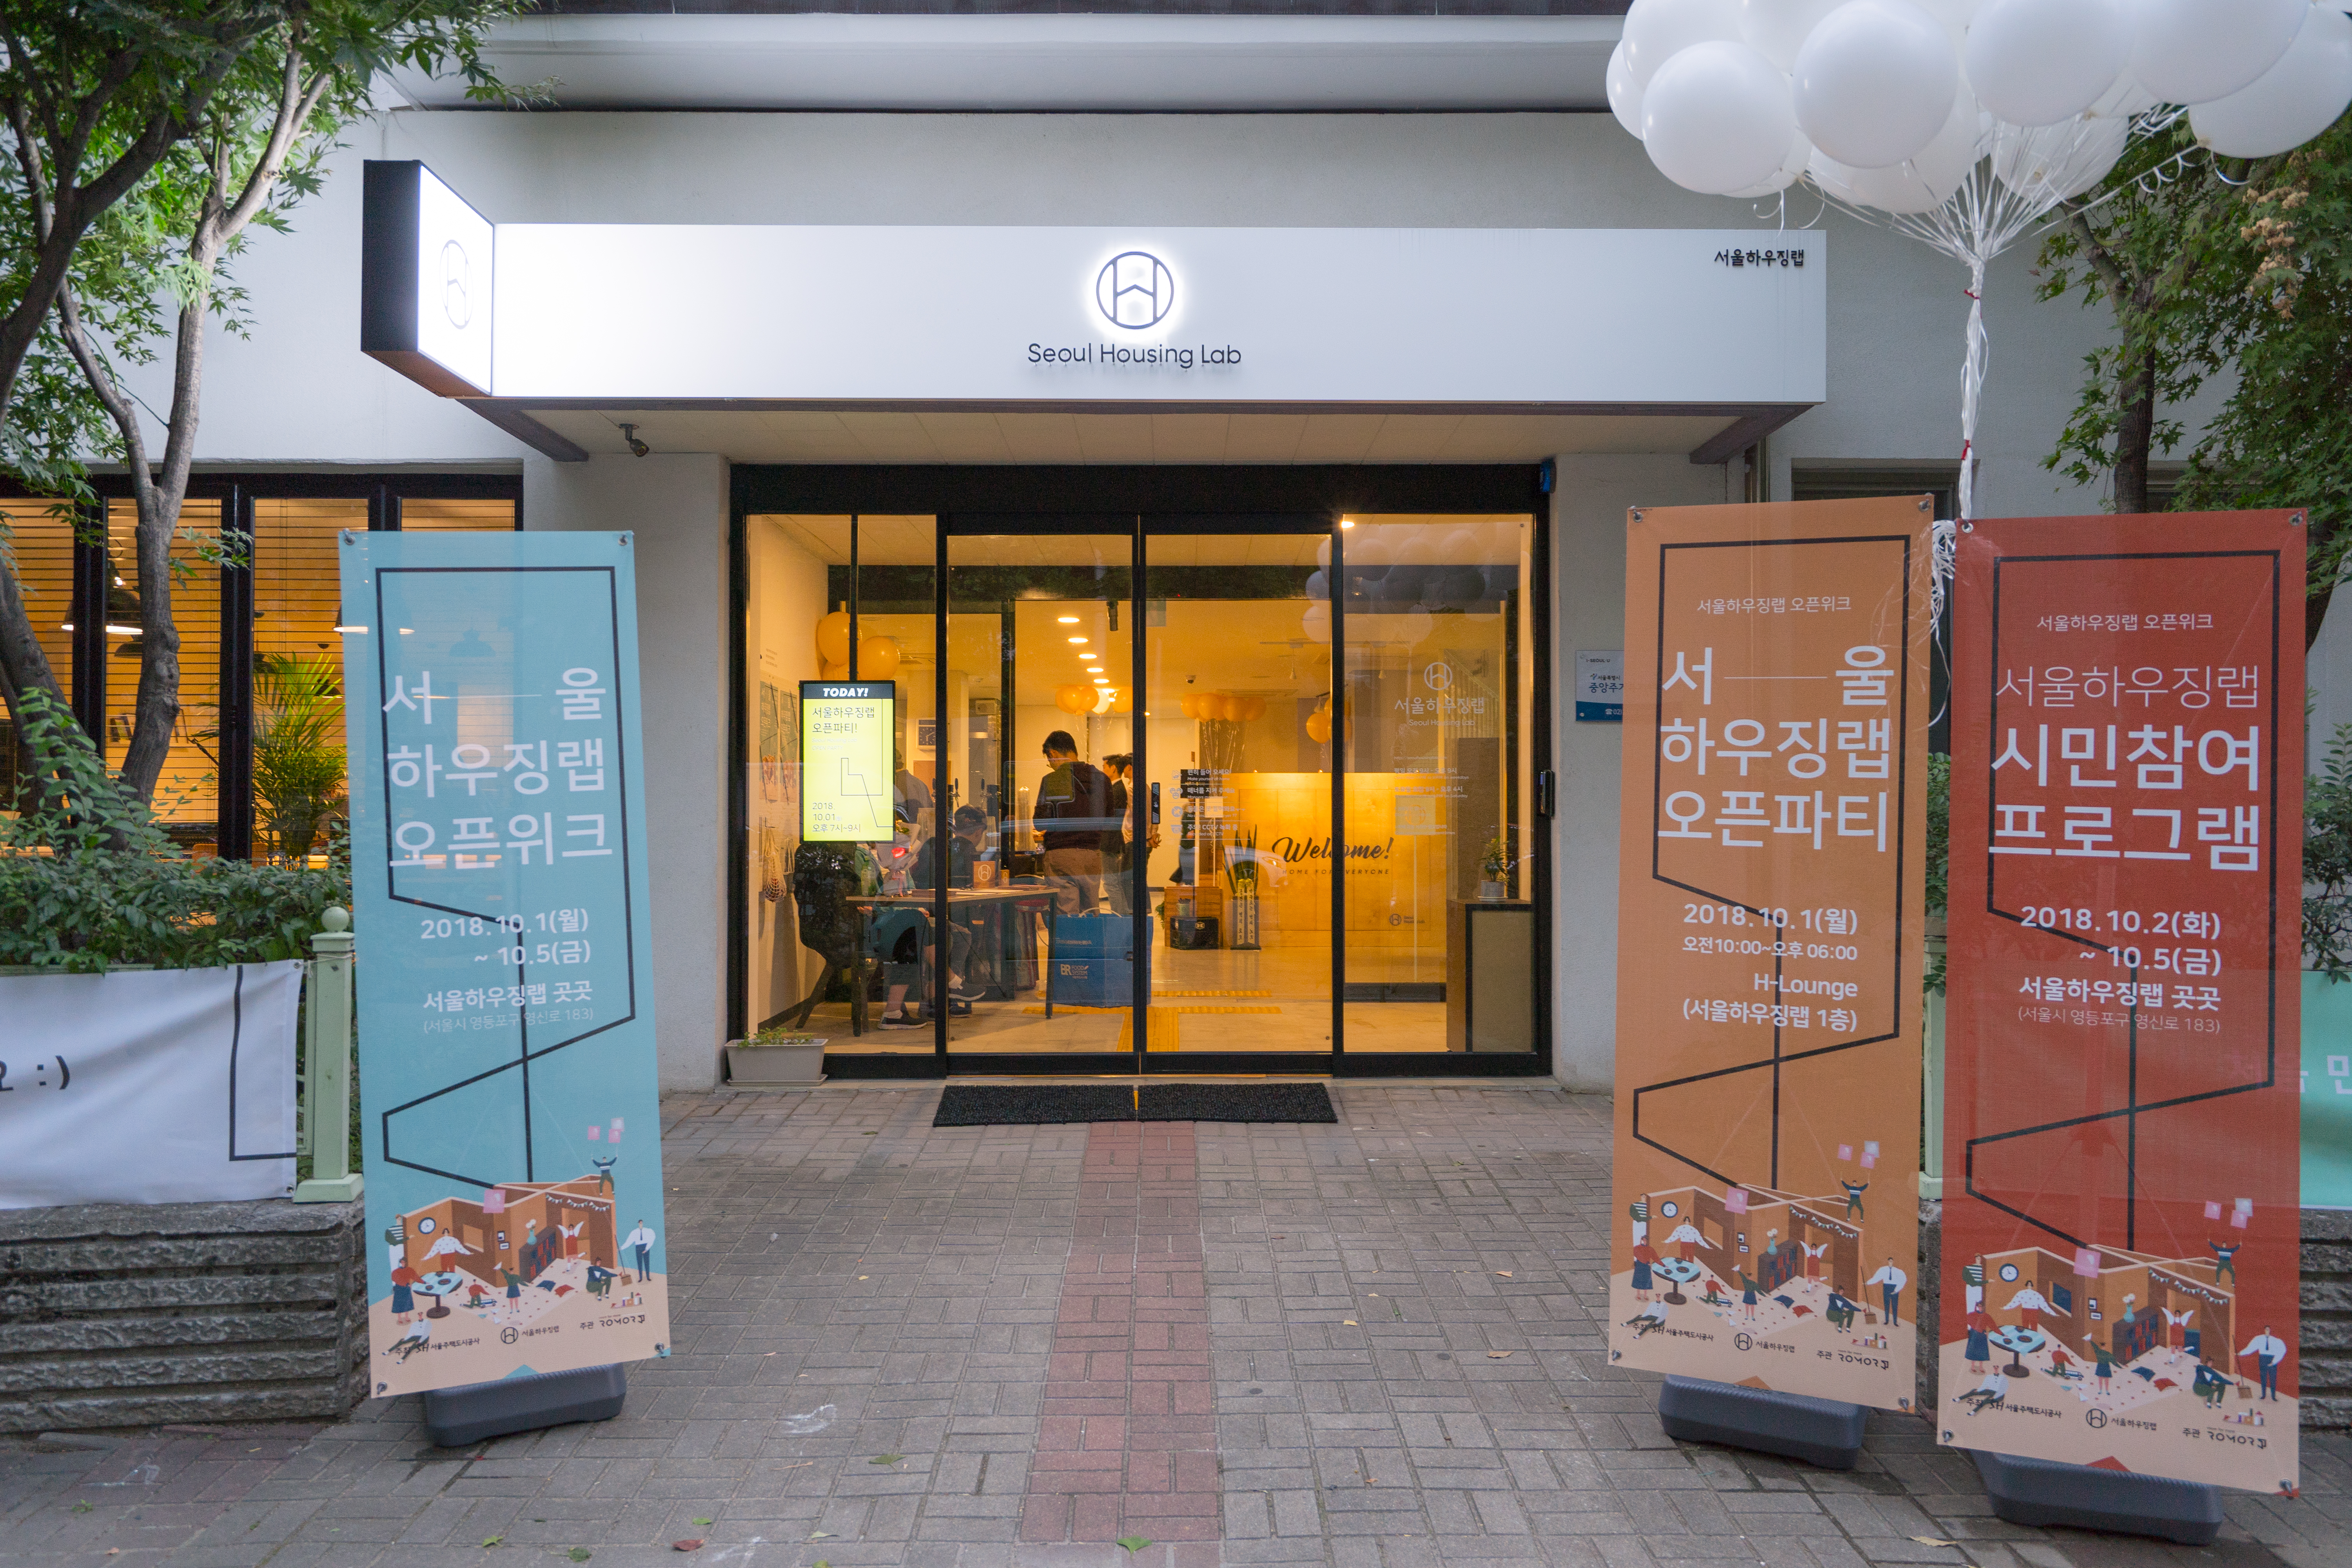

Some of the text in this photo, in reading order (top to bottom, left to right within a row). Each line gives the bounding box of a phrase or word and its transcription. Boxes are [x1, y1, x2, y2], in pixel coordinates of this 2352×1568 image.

[1714, 249, 1804, 267] 서울하우징랩
[1028, 343, 1241, 368] Seoul Housing Lab
[1697, 596, 1851, 615] 서울하우징랩 오픈위크
[2037, 613, 2214, 632] 서울하우징랩 오픈위크
[823, 688, 869, 697] TODAY!
[1996, 665, 2258, 709] 서울하우징랩
[812, 707, 874, 718] 서울하우징랩
[1394, 697, 1484, 714] 서울하우징랩
[812, 723, 857, 733] 오픈파티!
[1660, 718, 1889, 779] 하우징랩
[1991, 724, 2259, 791] 시민참여
[387, 738, 604, 799] 하우징랩
[812, 824, 860, 833] 오후 7시~9시
[1658, 790, 1886, 852] 오픈파티
[390, 812, 612, 870] 오픈위크
[1272, 837, 1394, 863] Welome!
[1988, 804, 2259, 871] 프로그램
[420, 909, 588, 939] 2018.10.1(월)
[1683, 904, 1857, 935] 2018.10.1(월)
[2020, 906, 2221, 940] 2018.10.2(화)
[497, 940, 590, 965] 10.5(금)
[1807, 945, 1858, 960] 06:00
[2107, 946, 2222, 976] 10.5(금)
[423, 980, 593, 1012] 서울하우징랩 곳곳
[1753, 973, 1858, 1001] H-Lounge
[2018, 976, 2221, 1012] 서울하우징랩 곳곳
[423, 1017, 466, 1033] (서울시
[565, 1007, 594, 1020] 183)
[1683, 998, 1857, 1033] (서울하우징랩 1층)
[2018, 1006, 2220, 1034] (서울시 영등포구 영신로 183)
[522, 1326, 559, 1336] 서울하우징랩
[580, 1321, 594, 1330] 주관
[1666, 1328, 1714, 1341] 서울주택도시공사
[431, 1337, 480, 1350] 서울주택도시공사
[1756, 1341, 1795, 1353] 서울하우징랩
[1817, 1350, 1832, 1359] 주관
[2005, 1404, 2062, 1418] 서울주택도시공사
[2111, 1418, 2157, 1431] 서울하우징랩
[2183, 1428, 2200, 1438] 주관
